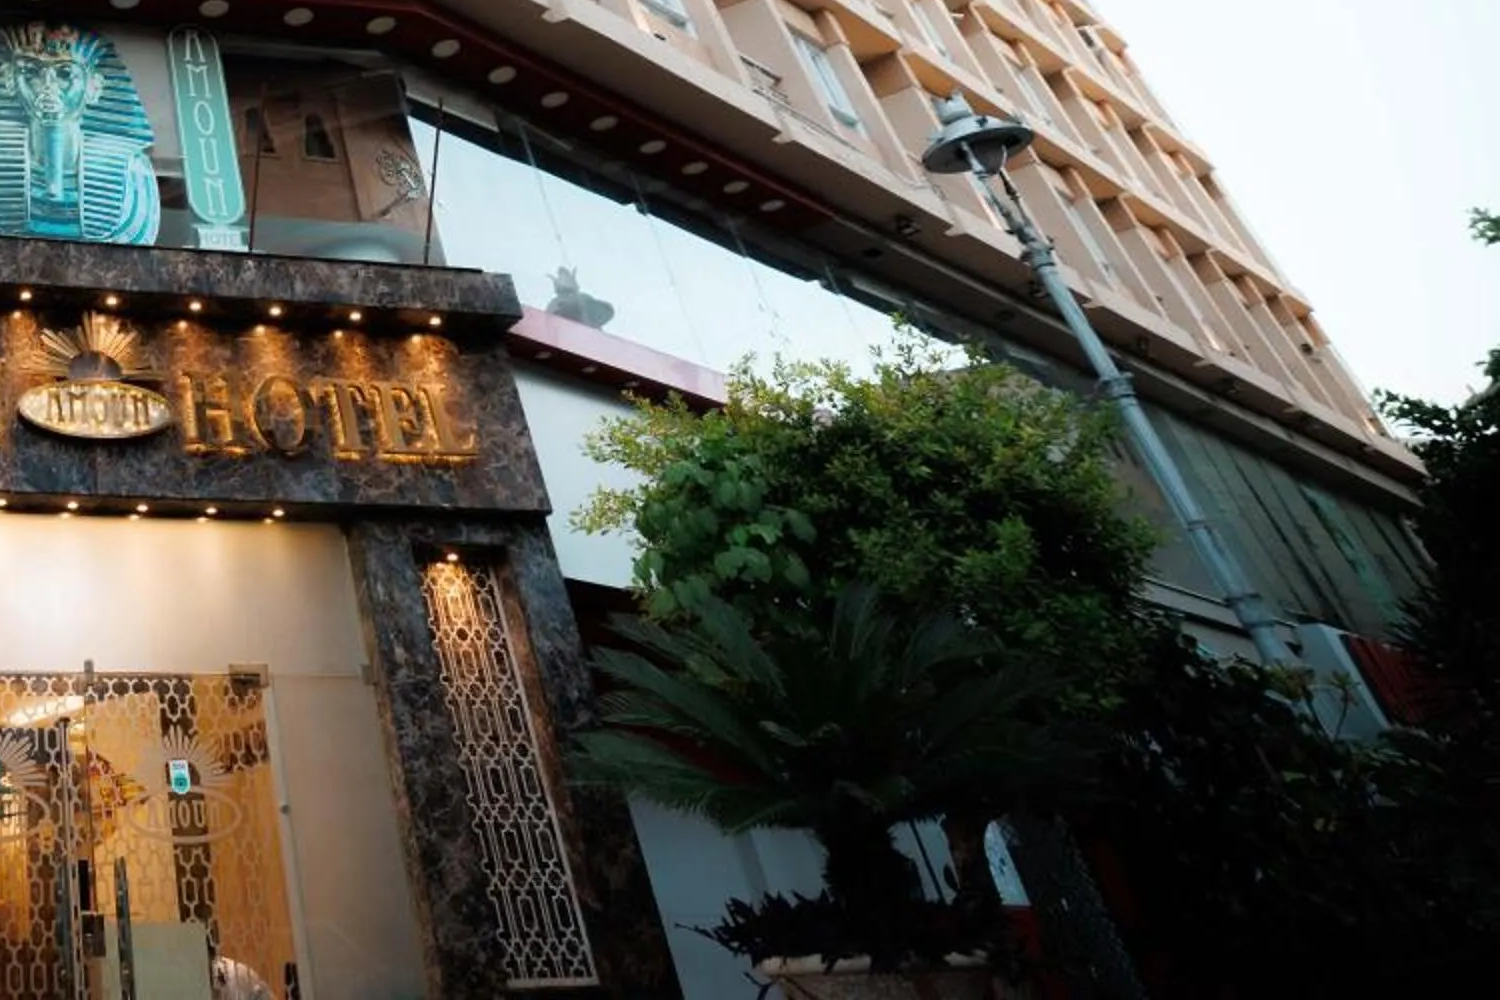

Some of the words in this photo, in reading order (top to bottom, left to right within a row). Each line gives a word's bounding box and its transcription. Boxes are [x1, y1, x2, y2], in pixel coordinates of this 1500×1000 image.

[184, 29, 229, 217] AMOUN
[46, 389, 151, 427] AMOUN
[180, 370, 479, 464] HOTEL
